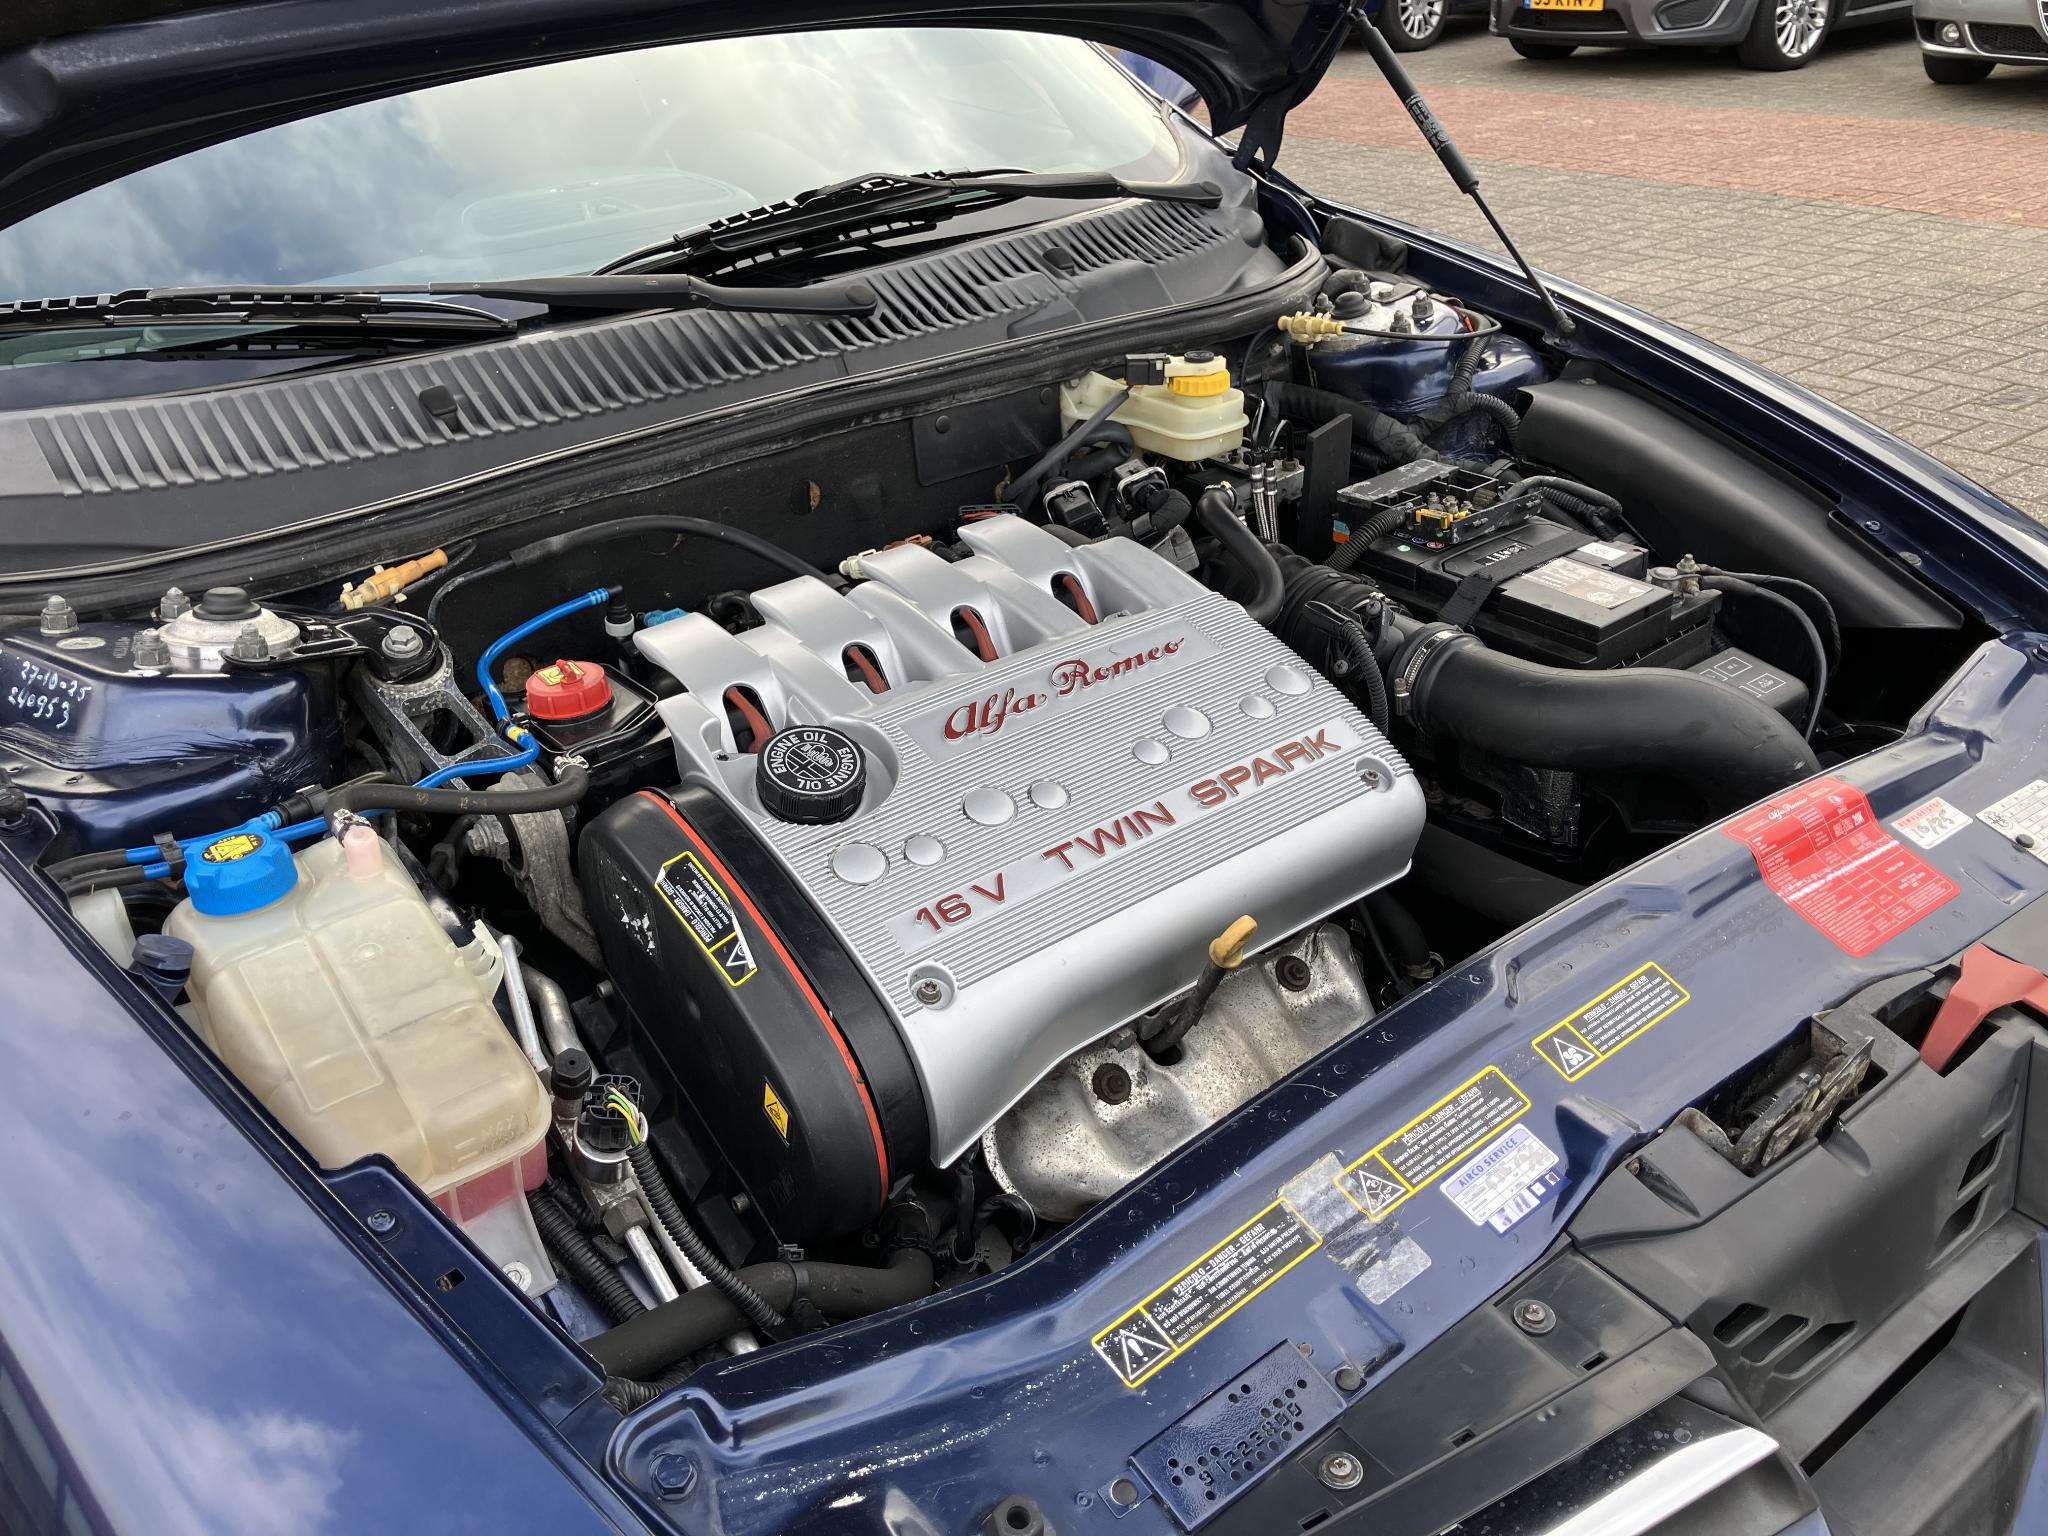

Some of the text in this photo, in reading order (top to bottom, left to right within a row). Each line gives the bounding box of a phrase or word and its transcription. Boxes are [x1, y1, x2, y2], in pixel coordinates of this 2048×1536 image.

[944, 637, 1185, 741] Alfa Romeo
[771, 731, 828, 774] ENGINE OIL
[797, 746, 855, 790] ENGINE OIL
[1041, 800, 1177, 871] TWIN
[1190, 728, 1342, 808] SPARK
[690, 918, 713, 943] PERICOLO
[1401, 1122, 1430, 1144] PERICOLO
[1431, 1104, 1455, 1123] DANGER
[1457, 1086, 1480, 1104] GEFAHR
[1458, 1137, 1518, 1188] AIRCO SERVICE
[1172, 1267, 1206, 1294] PERICOLO
[1208, 1244, 1236, 1267] DANGER
[1239, 1222, 1266, 1245] GEFAHR
